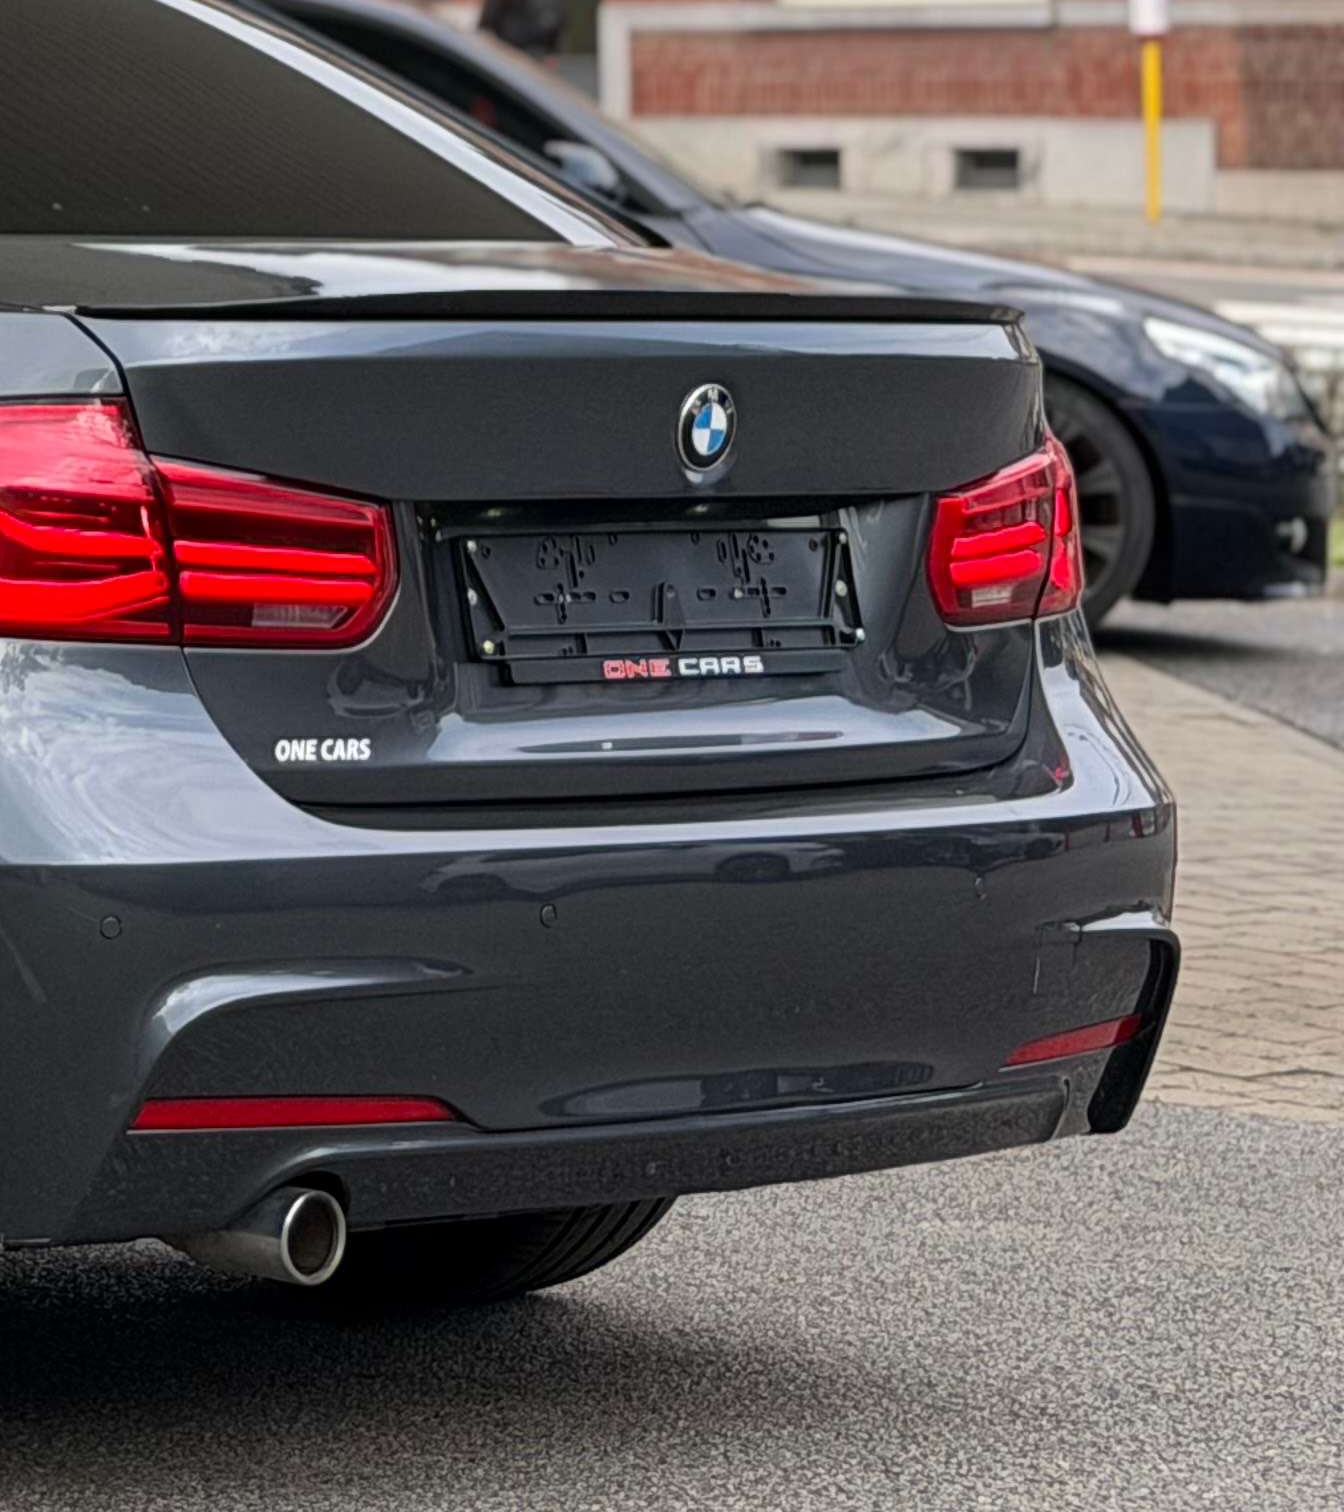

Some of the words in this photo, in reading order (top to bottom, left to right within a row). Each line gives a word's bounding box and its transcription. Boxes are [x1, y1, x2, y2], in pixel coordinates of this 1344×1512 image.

[602, 658, 672, 680] ONE
[678, 655, 764, 676] CARS
[274, 738, 318, 762] ONE
[320, 738, 372, 761] CARS
